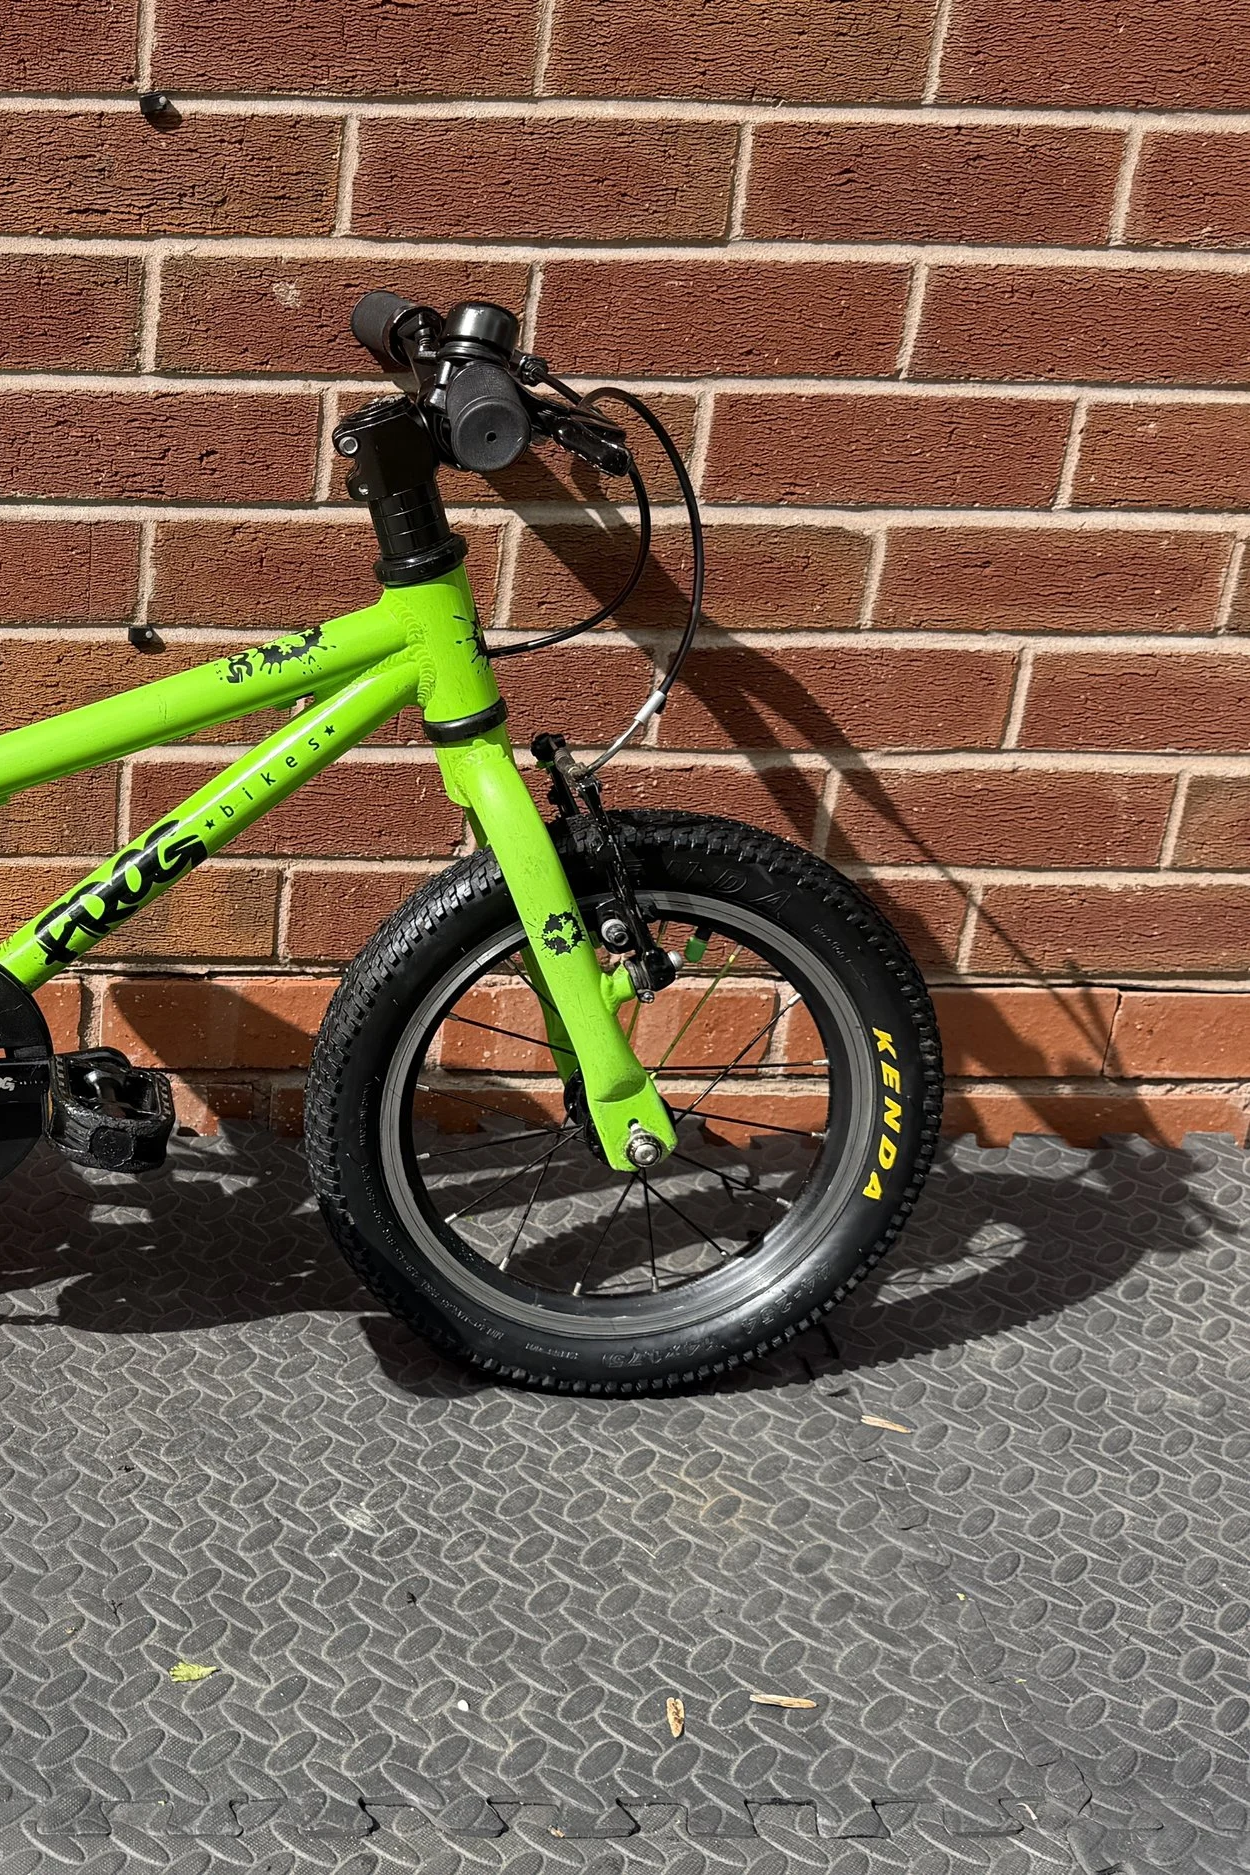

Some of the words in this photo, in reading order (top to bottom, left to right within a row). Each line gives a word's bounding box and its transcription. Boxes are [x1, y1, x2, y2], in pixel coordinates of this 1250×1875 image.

[34, 819, 208, 966] FROG
[219, 738, 320, 818] bikes
[862, 1026, 902, 1201] KENDA
